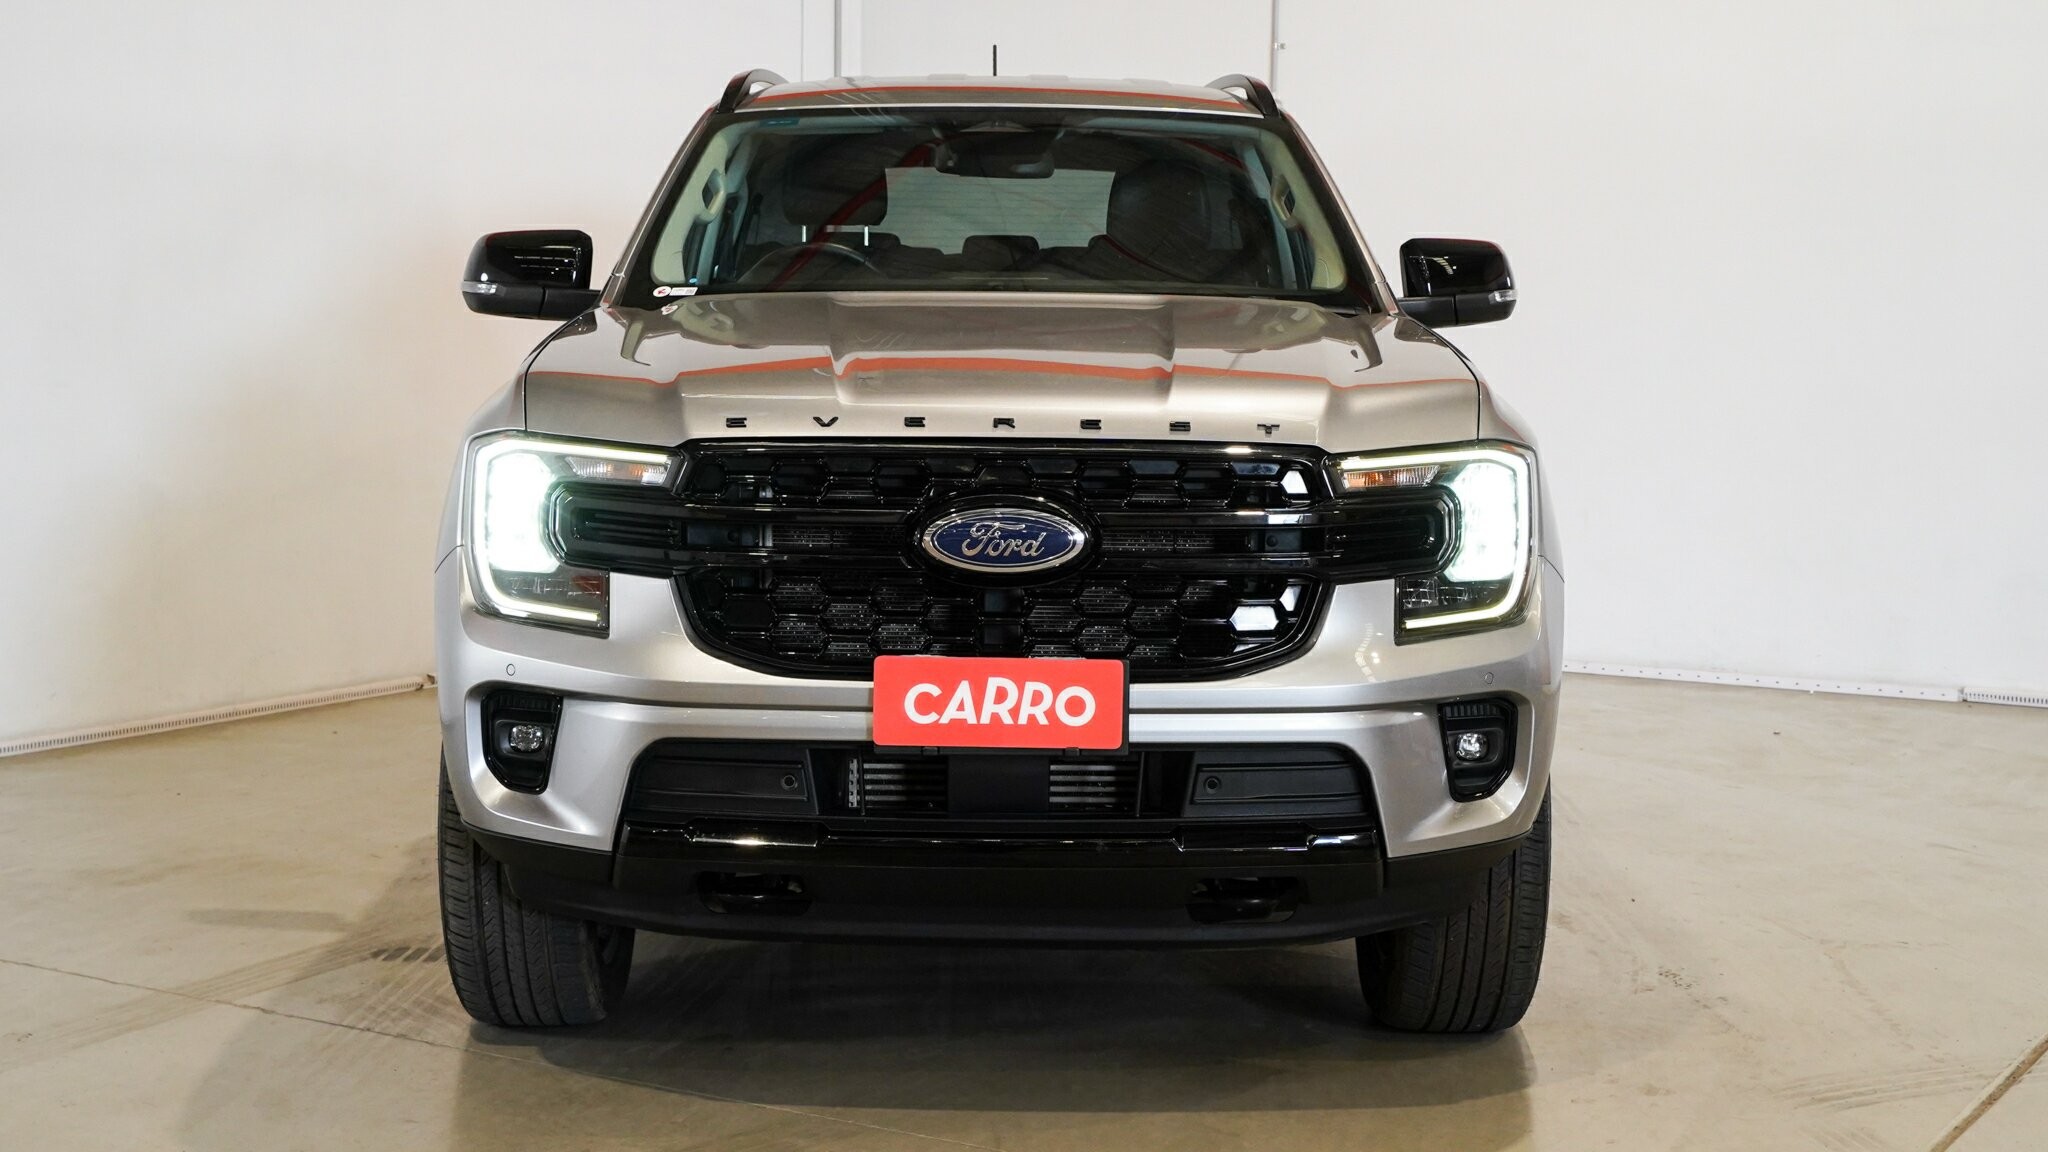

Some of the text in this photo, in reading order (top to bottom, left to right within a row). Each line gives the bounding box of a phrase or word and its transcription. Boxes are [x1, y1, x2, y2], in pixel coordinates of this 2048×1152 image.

[726, 417, 1280, 435] EVEREST
[962, 522, 1046, 557] Ford
[904, 677, 1096, 727] CARRO
